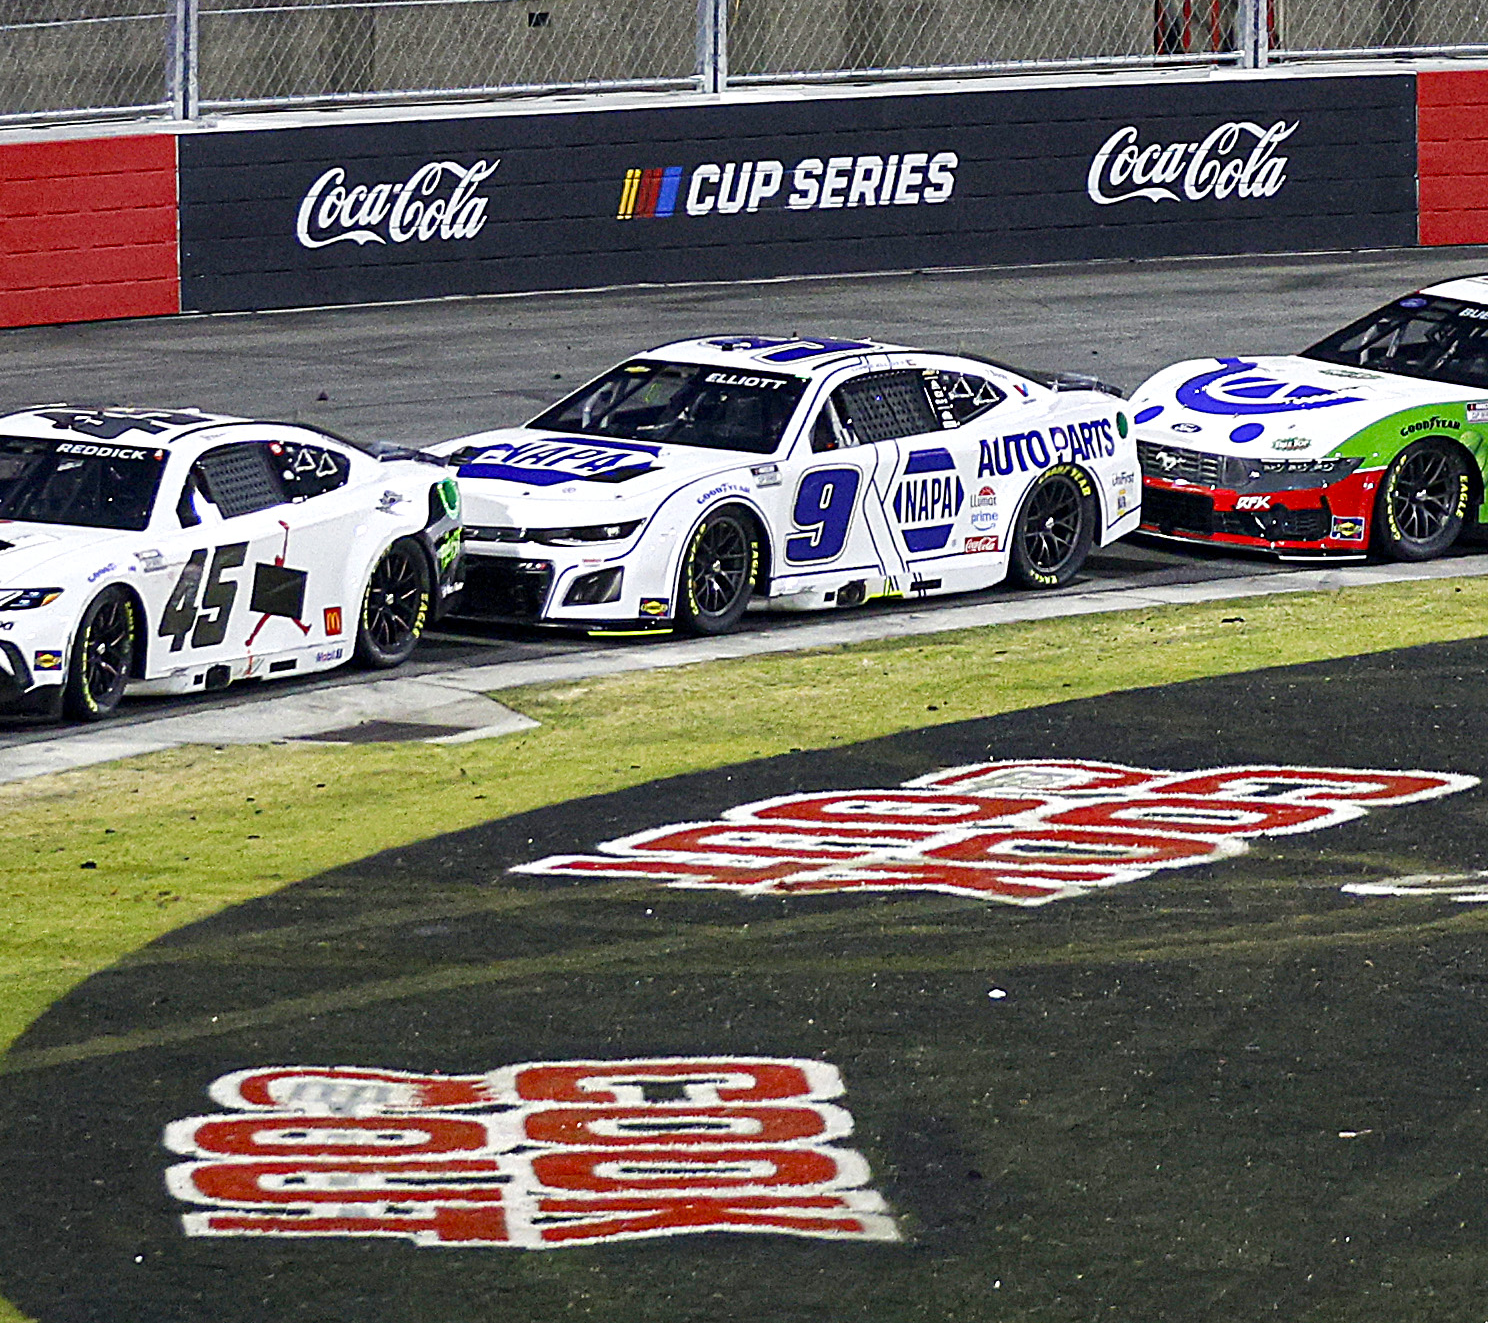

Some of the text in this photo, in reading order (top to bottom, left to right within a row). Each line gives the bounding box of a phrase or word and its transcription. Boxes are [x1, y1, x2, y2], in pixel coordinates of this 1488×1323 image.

[686, 151, 957, 217] CUP SERIES
[705, 372, 787, 389] ELLIOTT
[1400, 415, 1461, 438] GOODYEAR
[55, 443, 147, 461] REDDICK
[977, 417, 1115, 479] AUTO PARTS
[785, 466, 862, 564] 9
[904, 481, 955, 521] NAPA
[970, 510, 999, 525] prime
[158, 541, 250, 653] 45
